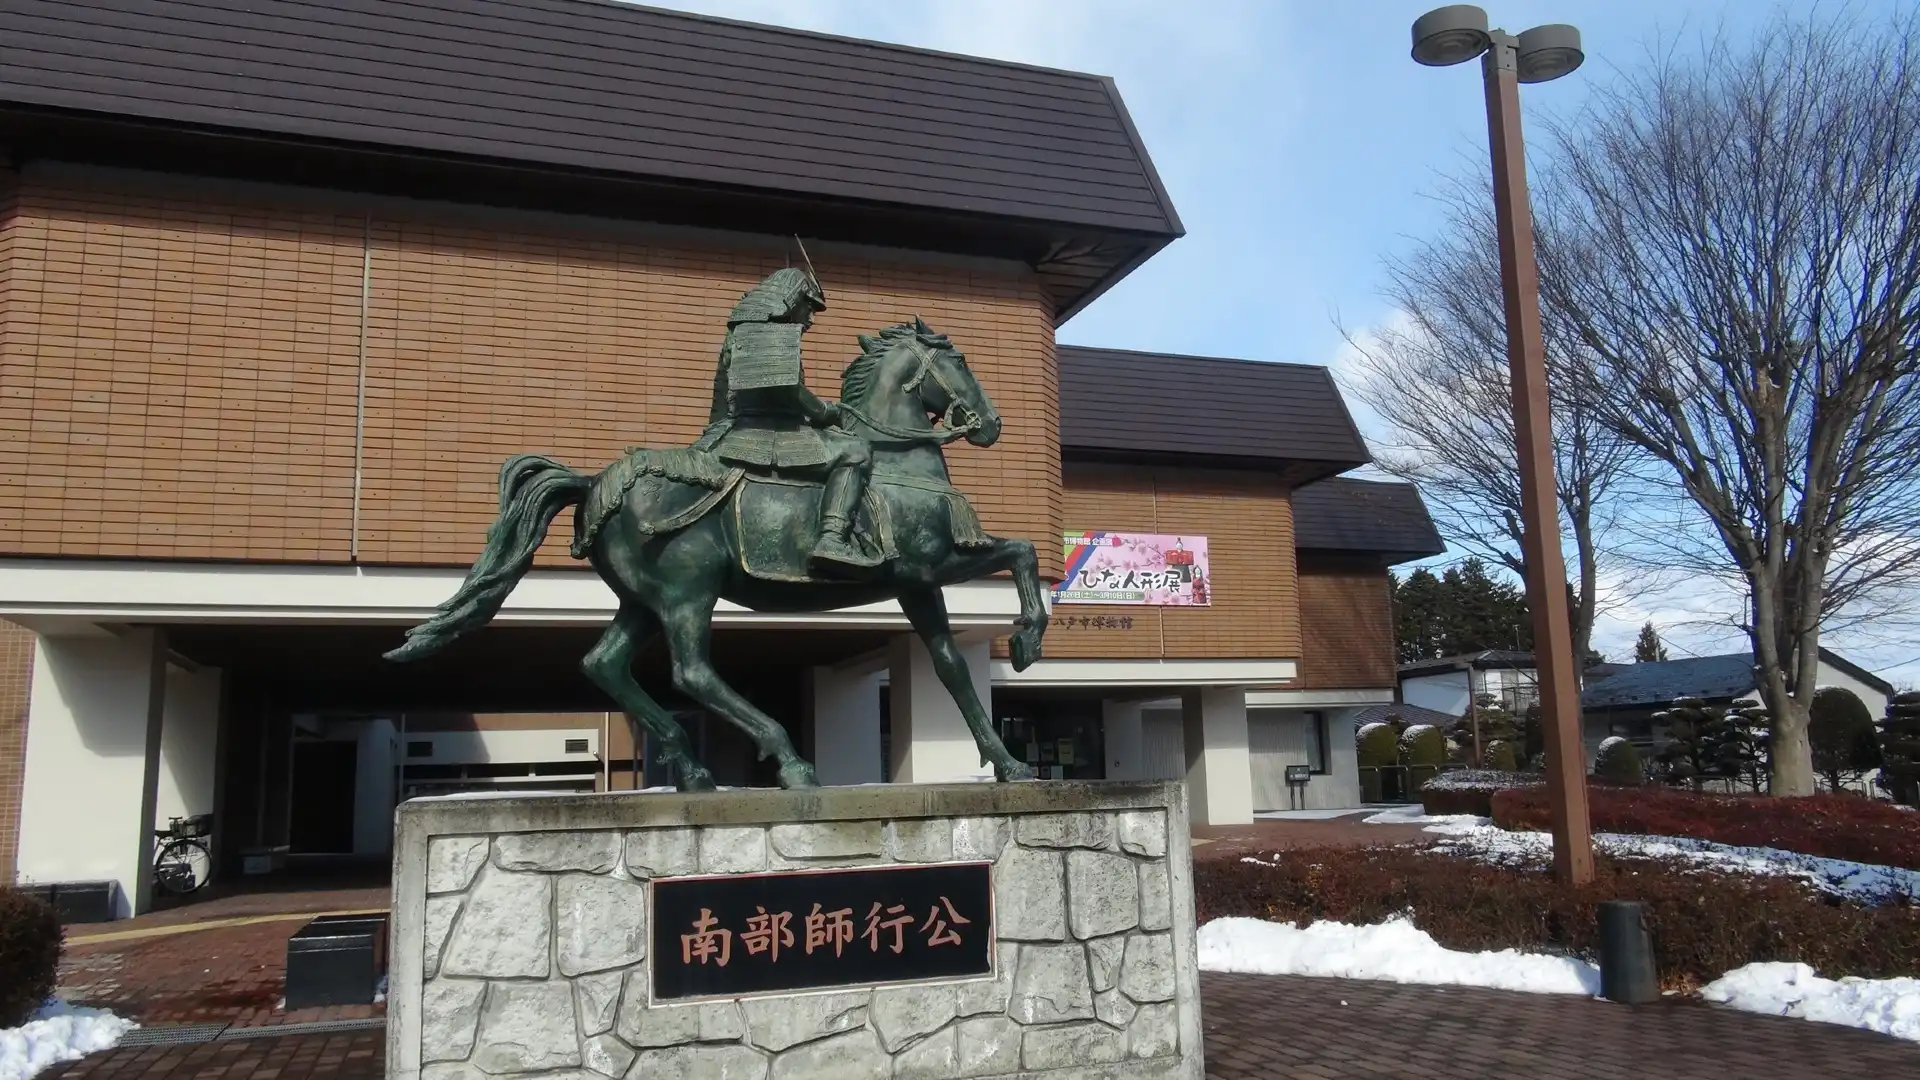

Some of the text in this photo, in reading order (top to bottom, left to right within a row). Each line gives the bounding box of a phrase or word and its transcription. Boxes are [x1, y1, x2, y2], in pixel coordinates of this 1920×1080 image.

[1080, 569, 1181, 593] ひな人形展
[680, 896, 971, 967] 南部師行公
